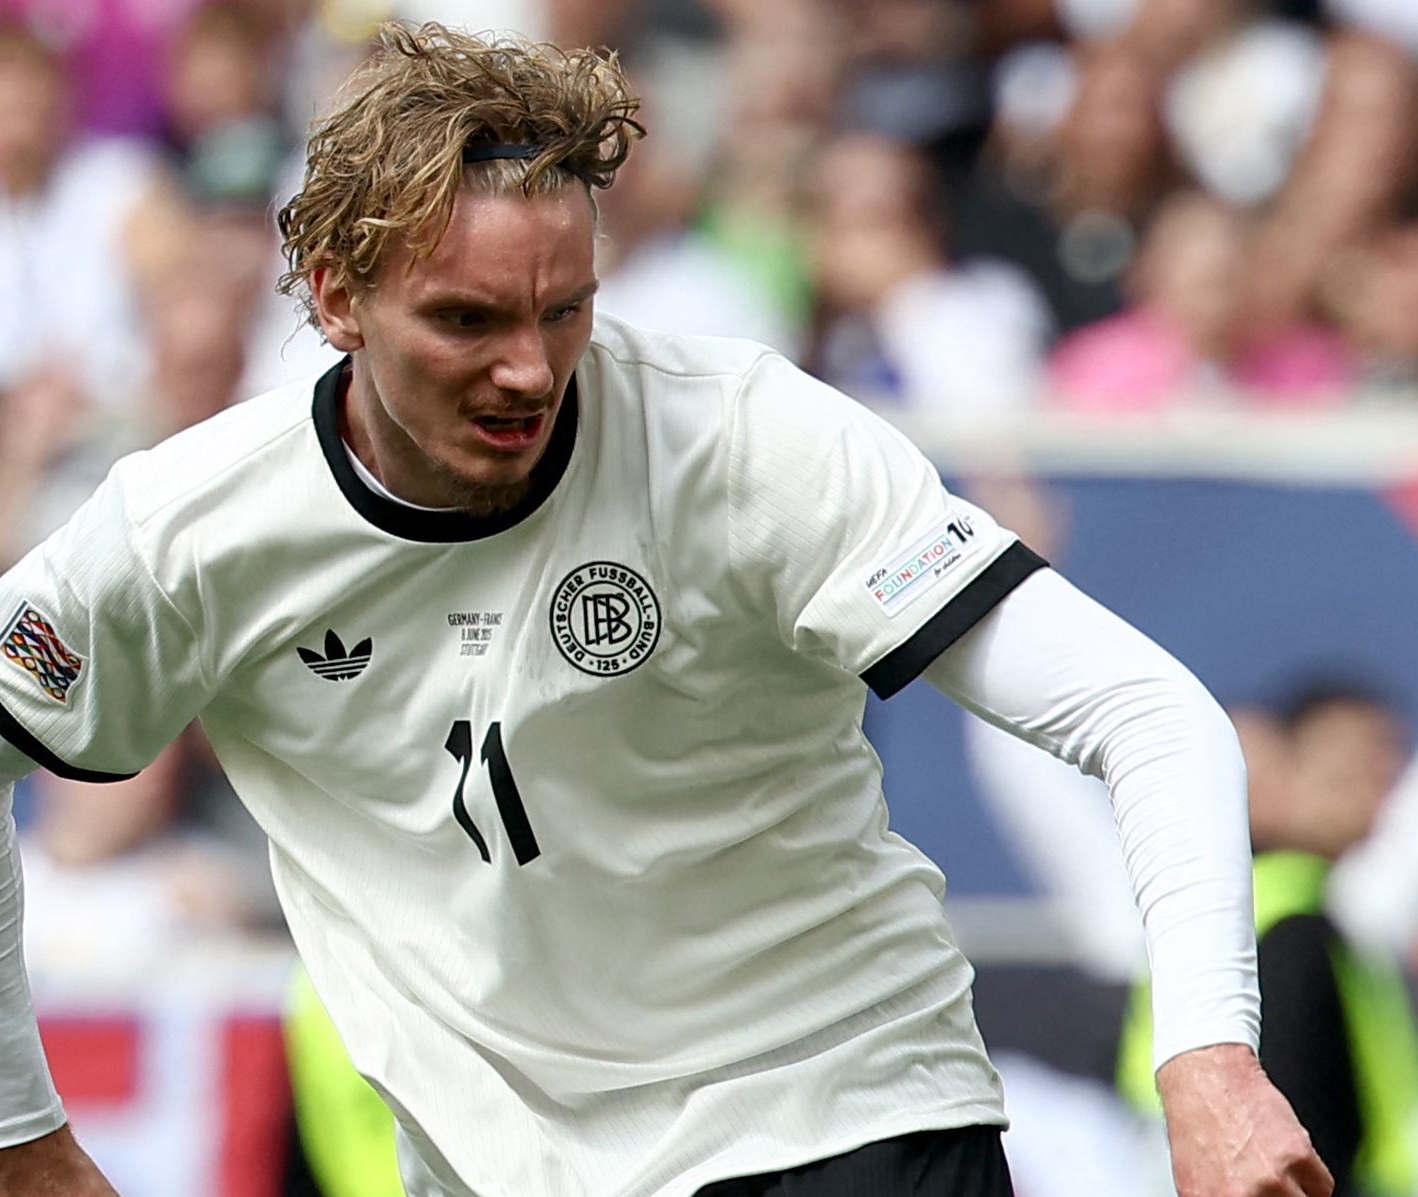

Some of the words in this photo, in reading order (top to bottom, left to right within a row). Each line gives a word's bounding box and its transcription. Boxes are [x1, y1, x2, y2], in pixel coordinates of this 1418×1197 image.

[947, 517, 974, 543] 10
[874, 537, 954, 602] FOUNDATION
[466, 628, 481, 641] JUNE
[556, 573, 586, 663] DEUTSCHER
[596, 659, 620, 671] 125
[444, 719, 542, 867] 11
